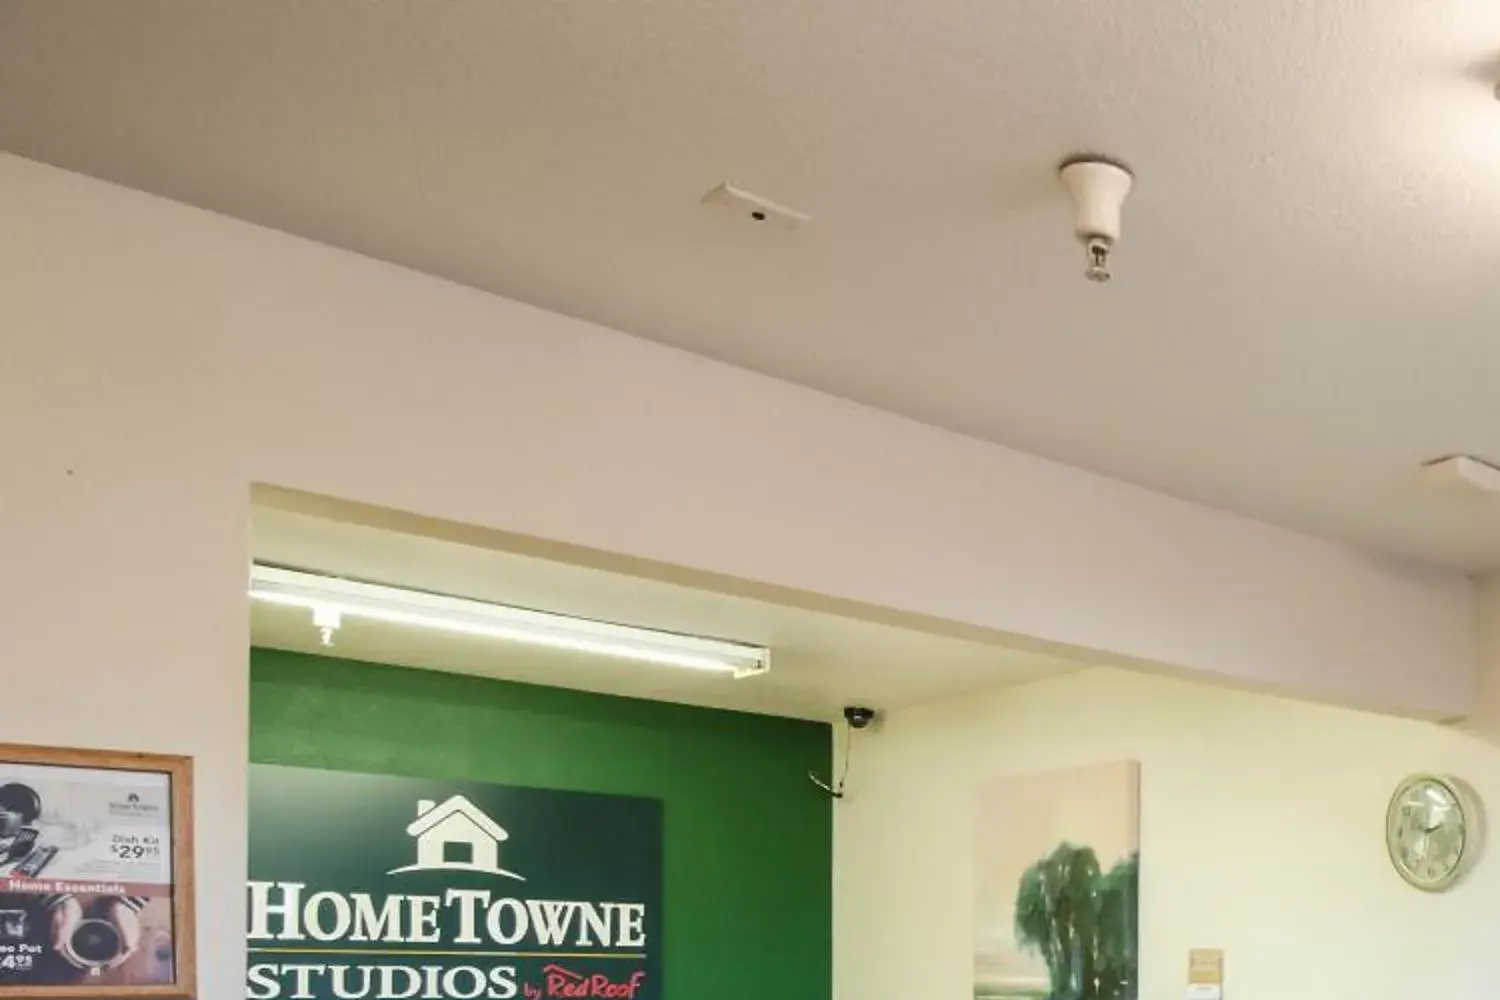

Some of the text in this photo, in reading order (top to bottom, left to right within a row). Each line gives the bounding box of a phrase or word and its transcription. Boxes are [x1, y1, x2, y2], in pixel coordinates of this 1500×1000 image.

[9, 880, 126, 894] Home Essentials
[246, 963, 518, 999] STUDIOS
